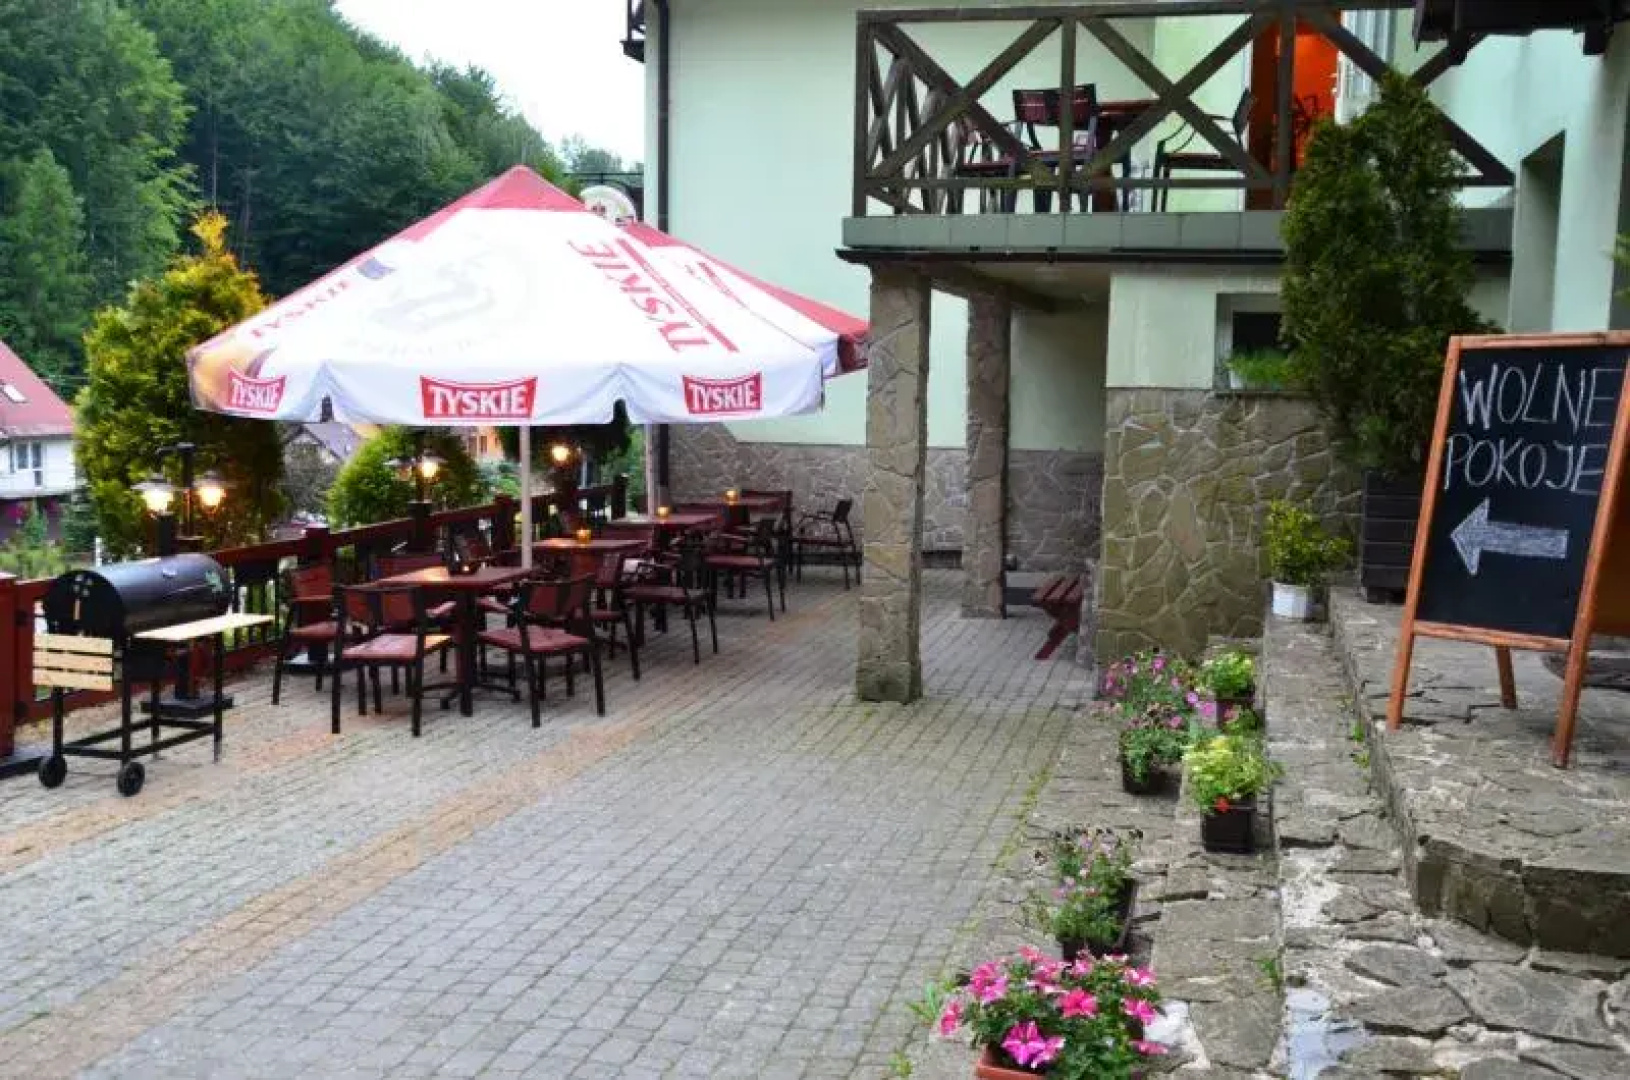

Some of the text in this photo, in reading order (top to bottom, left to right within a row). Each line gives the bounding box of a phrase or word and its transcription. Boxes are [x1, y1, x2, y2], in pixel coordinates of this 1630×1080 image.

[566, 239, 711, 353] TYSKIE
[231, 378, 281, 409] TYSKIE
[427, 385, 527, 415] TYSKIE
[687, 380, 756, 411] TYSKIE
[1459, 362, 1623, 435] WOLNE
[1444, 433, 1608, 496] POKOJE
